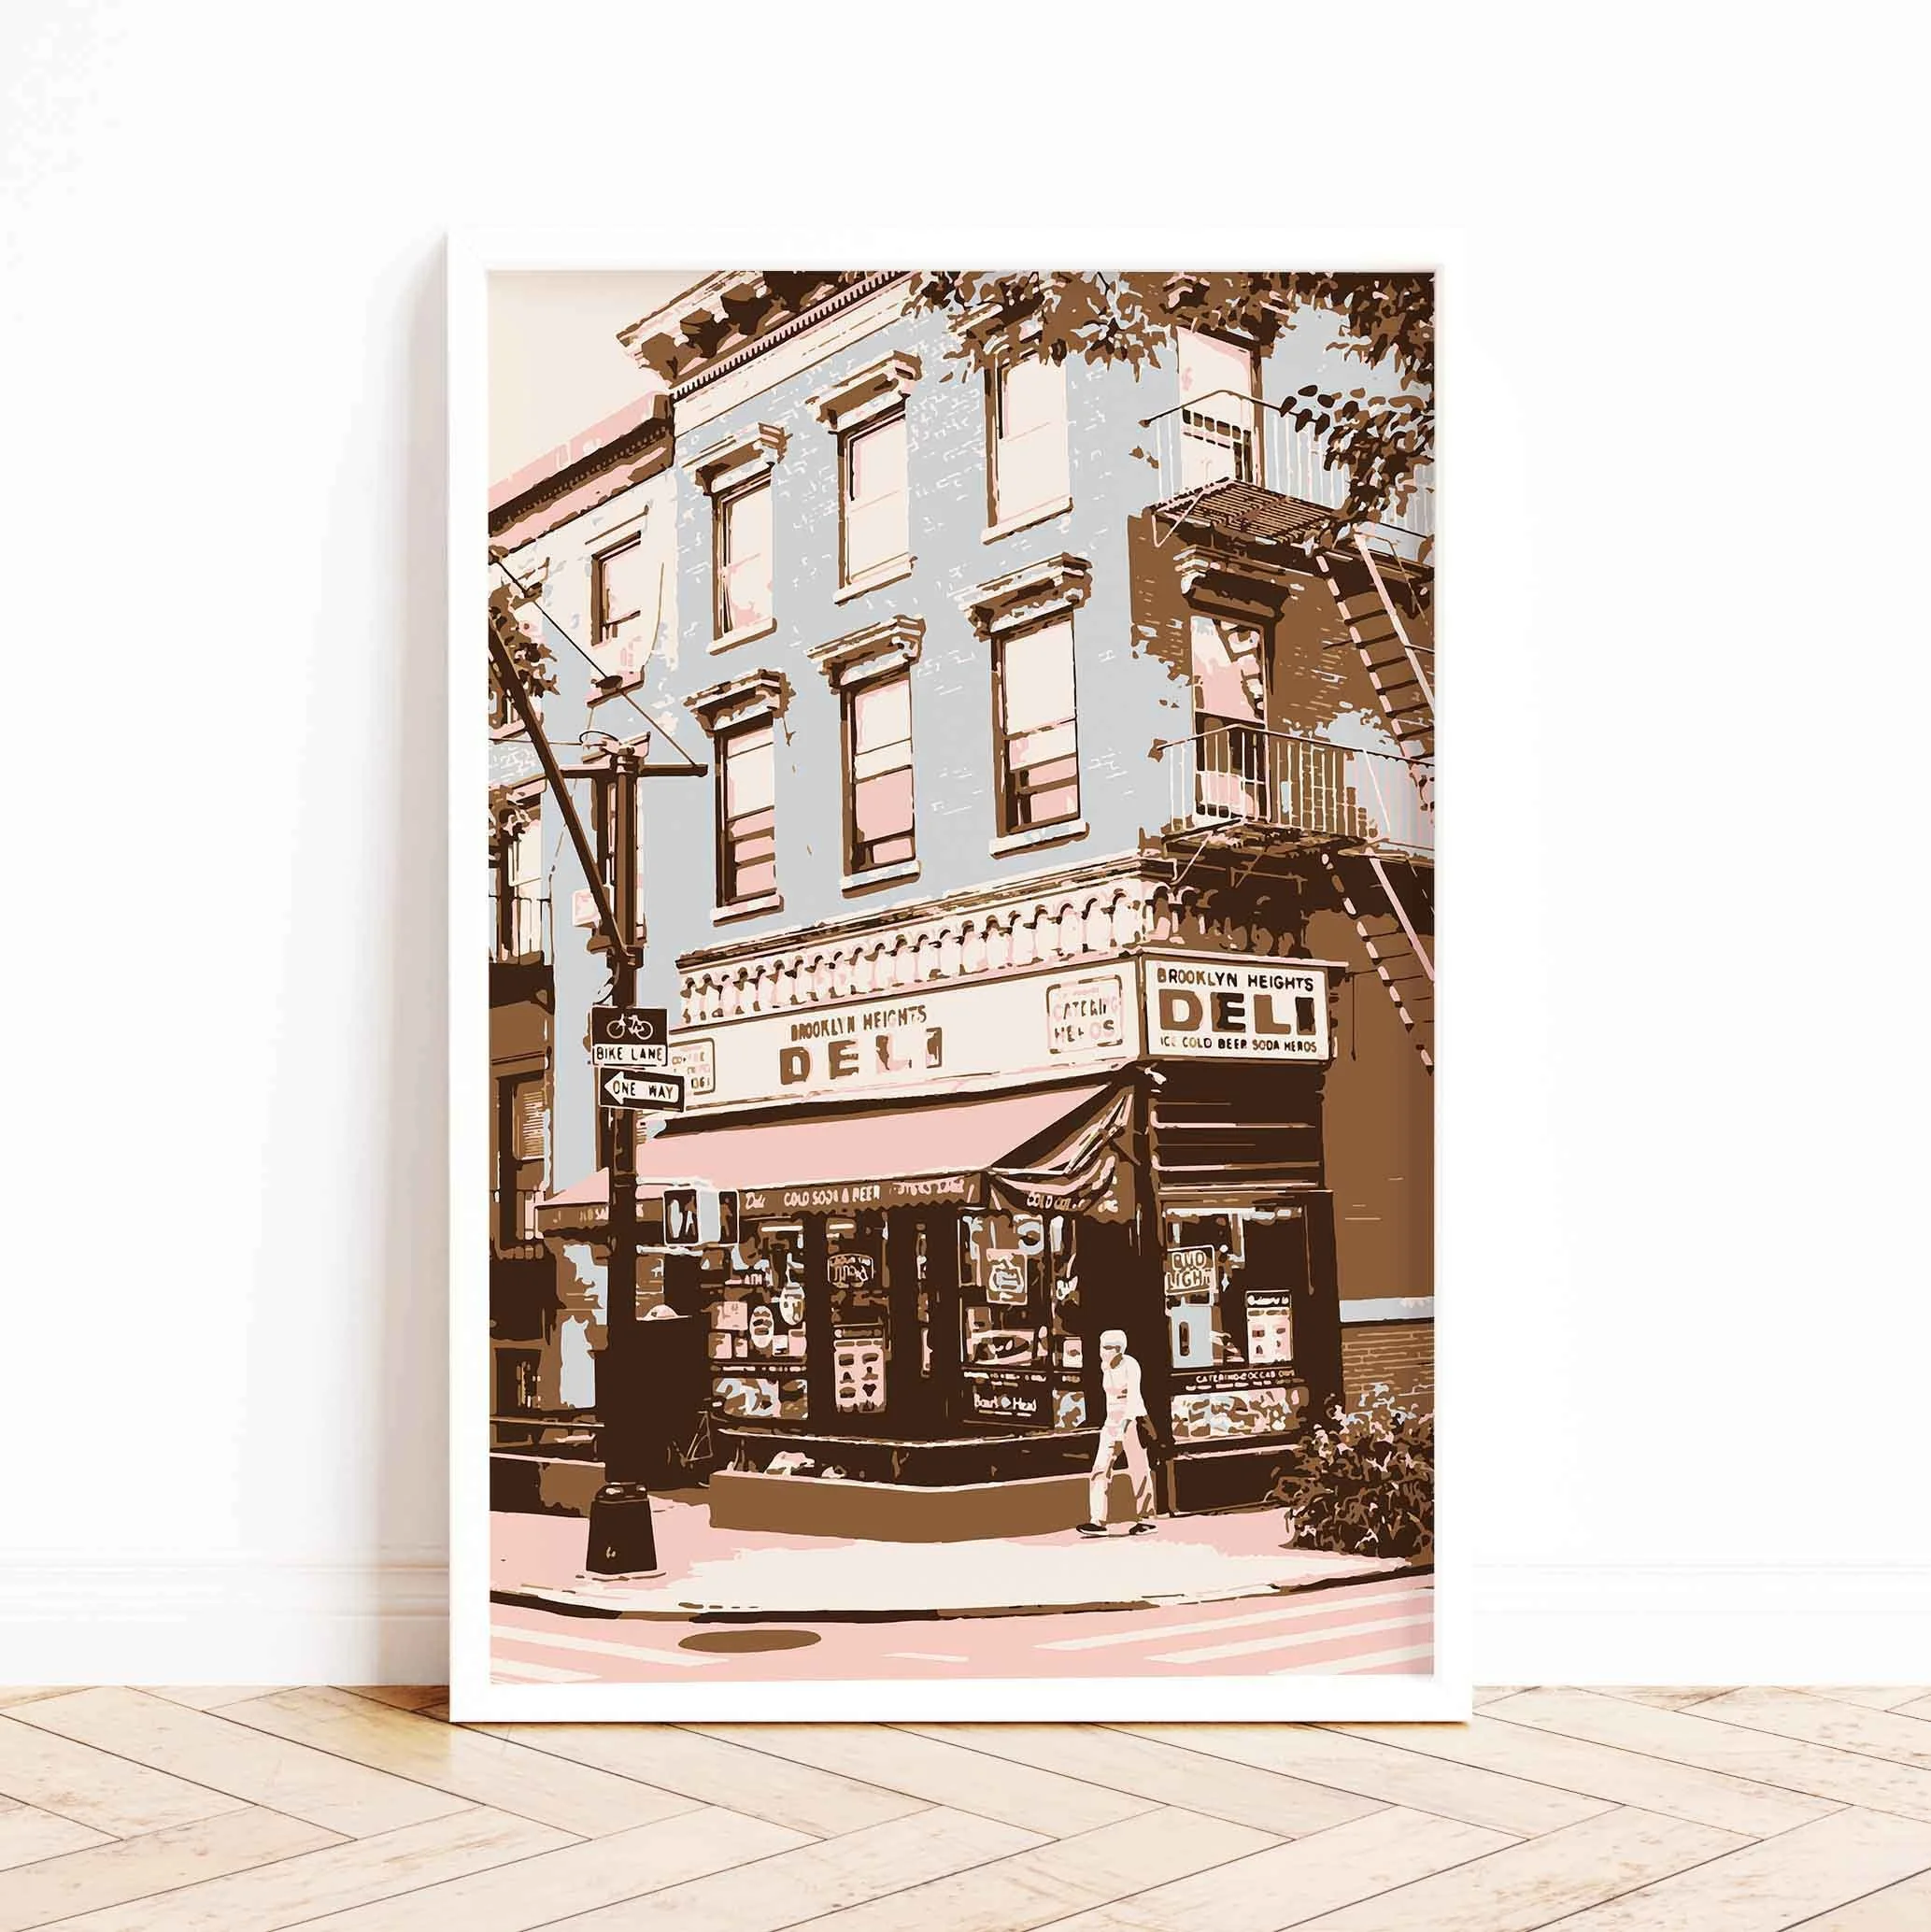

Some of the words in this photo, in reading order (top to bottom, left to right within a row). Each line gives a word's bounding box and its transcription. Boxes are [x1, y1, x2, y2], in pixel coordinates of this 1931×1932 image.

[1157, 968, 1238, 987] BROOKLYN
[1247, 974, 1314, 992] HEIGHTS
[1158, 988, 1316, 1036] DELI
[790, 1016, 856, 1043] BROOKLYN
[863, 1004, 928, 1030] HEIGHTS
[596, 1046, 623, 1061] BIKE
[631, 1047, 663, 1061] LANE
[1182, 1037, 1213, 1048] COLD
[1252, 1039, 1280, 1052] SODA
[612, 1080, 636, 1096] ONE
[648, 1085, 674, 1100] WAY
